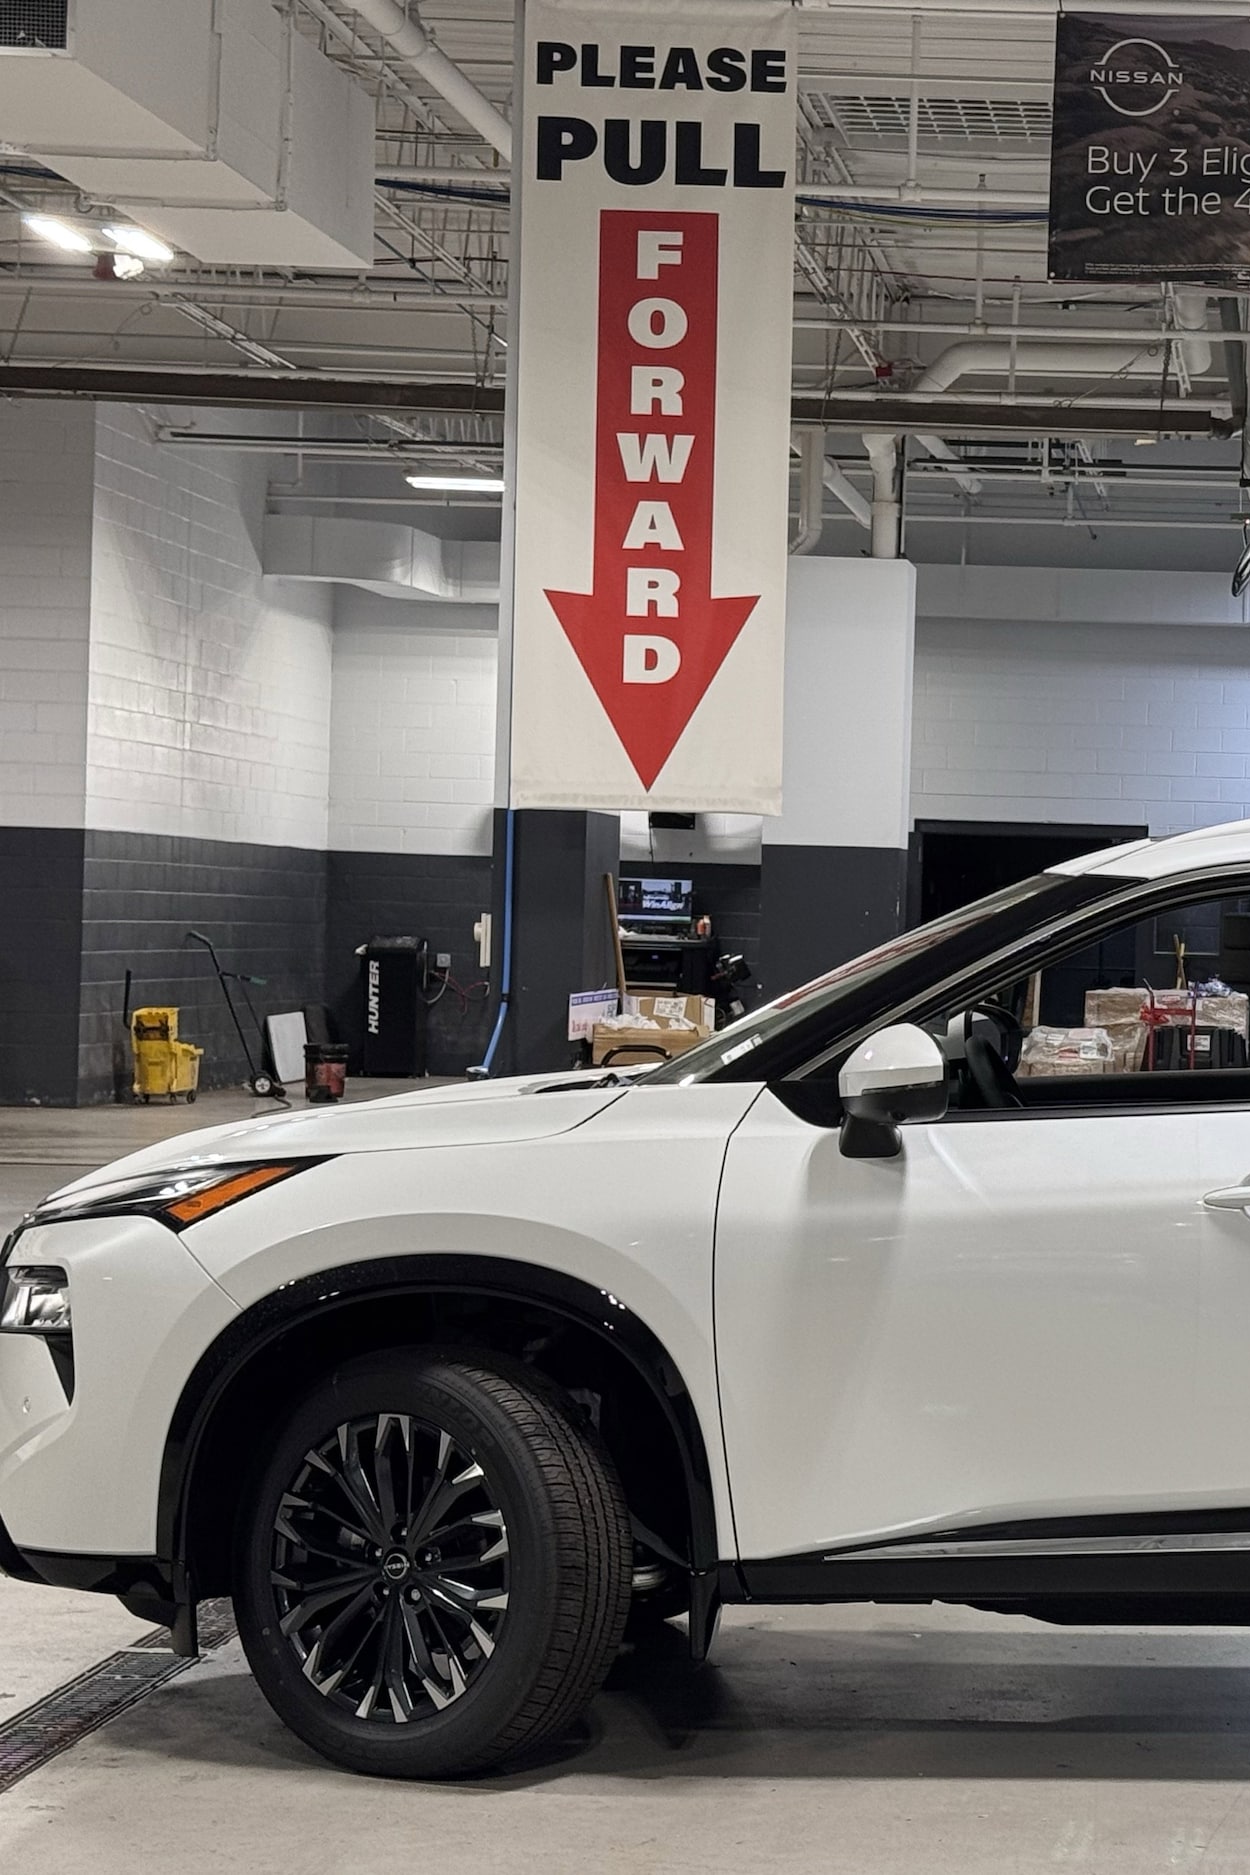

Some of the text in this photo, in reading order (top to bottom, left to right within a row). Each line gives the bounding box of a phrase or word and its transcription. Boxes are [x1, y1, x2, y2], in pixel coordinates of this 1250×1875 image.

[536, 41, 787, 93] PLEASE
[1090, 69, 1183, 85] NISSAN
[536, 116, 787, 188] PULL
[1087, 146, 1157, 183] Buy
[1169, 148, 1188, 177] 3
[1086, 186, 1150, 216] Get
[1161, 186, 1222, 217] the
[616, 230, 695, 684] FORWARD
[368, 960, 379, 1034] HUNTER
